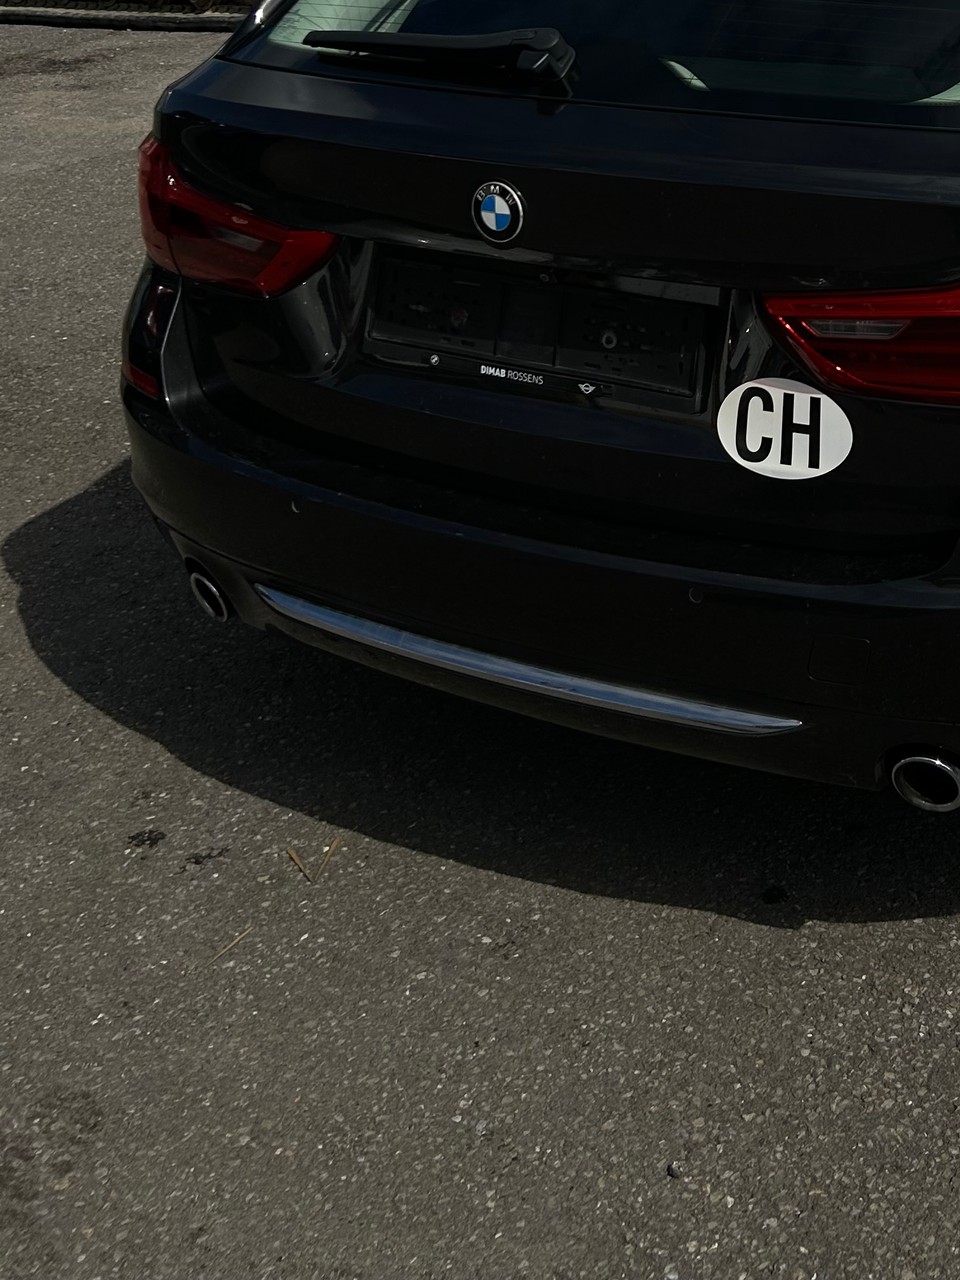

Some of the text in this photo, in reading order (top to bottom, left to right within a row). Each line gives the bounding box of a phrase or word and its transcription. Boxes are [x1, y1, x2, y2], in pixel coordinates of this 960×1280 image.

[476, 184, 517, 206] BMW
[480, 364, 544, 385] DIMAB ROSSENS
[735, 386, 821, 470] CH
